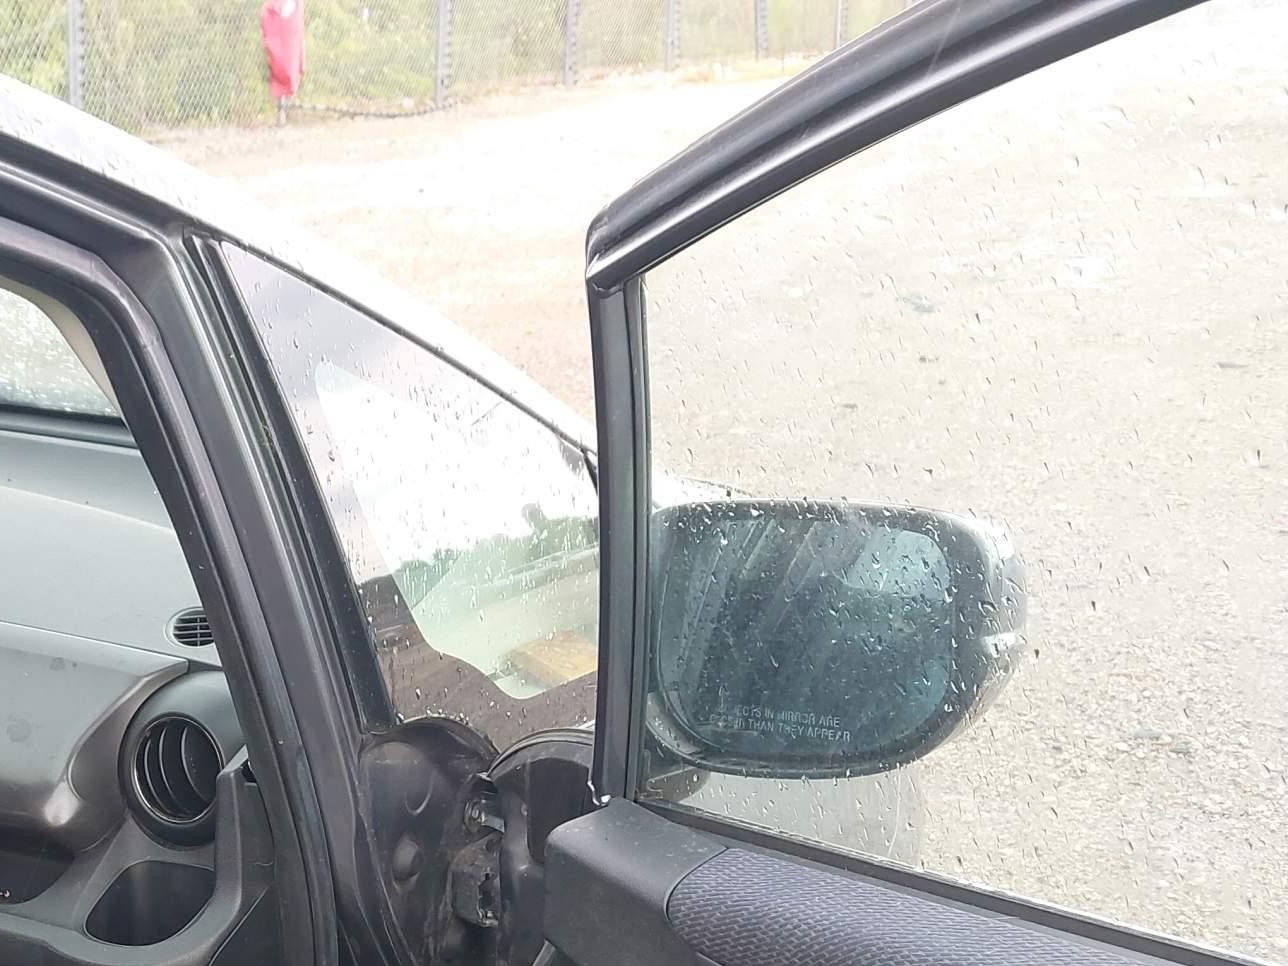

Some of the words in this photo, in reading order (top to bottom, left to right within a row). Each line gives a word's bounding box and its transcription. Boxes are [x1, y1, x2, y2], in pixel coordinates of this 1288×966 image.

[748, 718, 774, 732] THAN
[764, 707, 774, 719] IN
[819, 715, 841, 728] ARE
